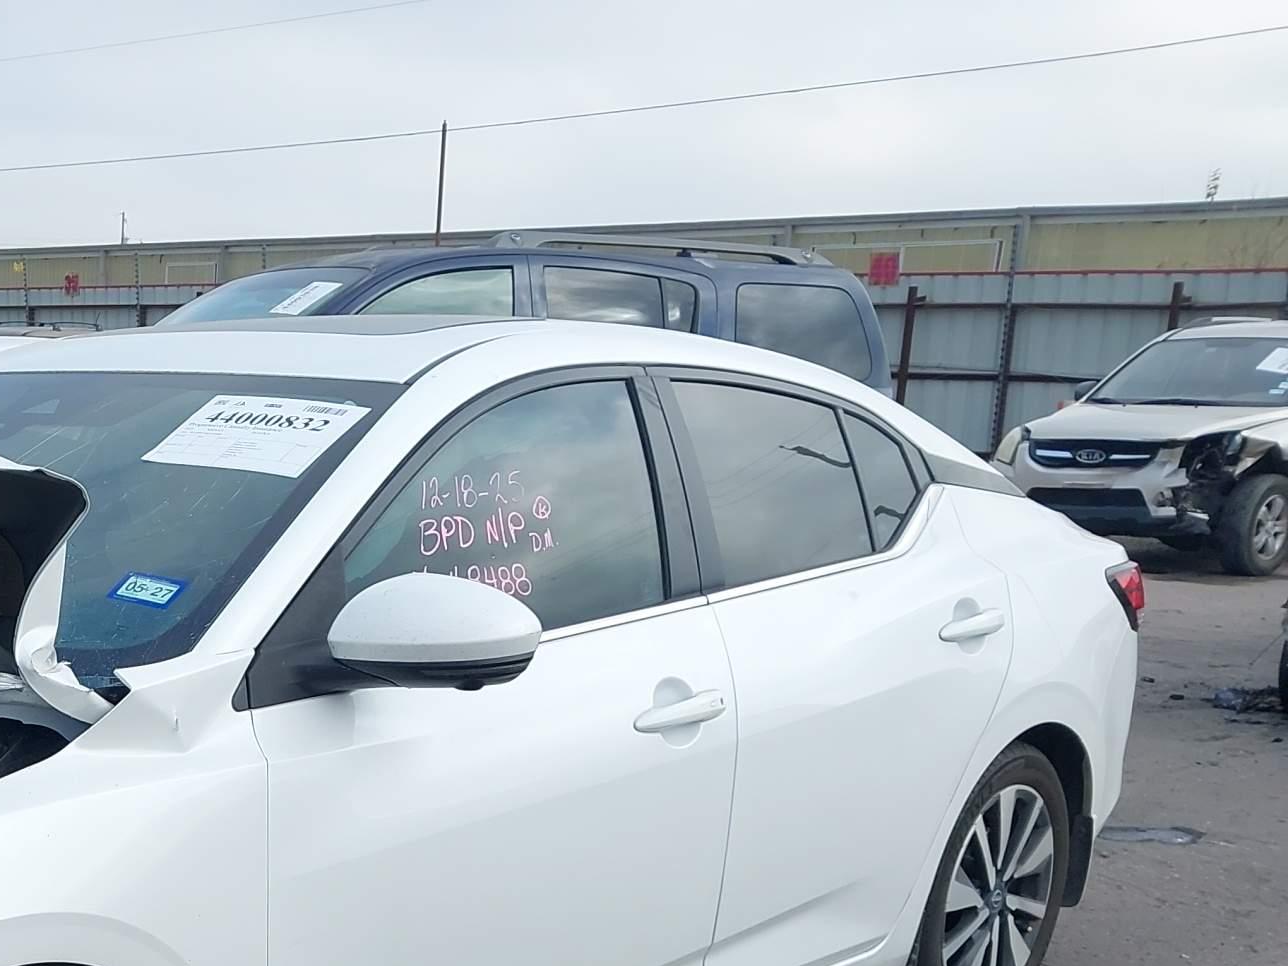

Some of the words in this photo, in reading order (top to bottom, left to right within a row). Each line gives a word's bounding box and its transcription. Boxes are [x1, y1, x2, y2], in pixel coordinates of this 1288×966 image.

[206, 411, 330, 431] 44000832
[1079, 451, 1102, 461] KIA
[421, 470, 524, 509] 12-18-25
[419, 515, 475, 556] BPD
[486, 507, 525, 548] N/P
